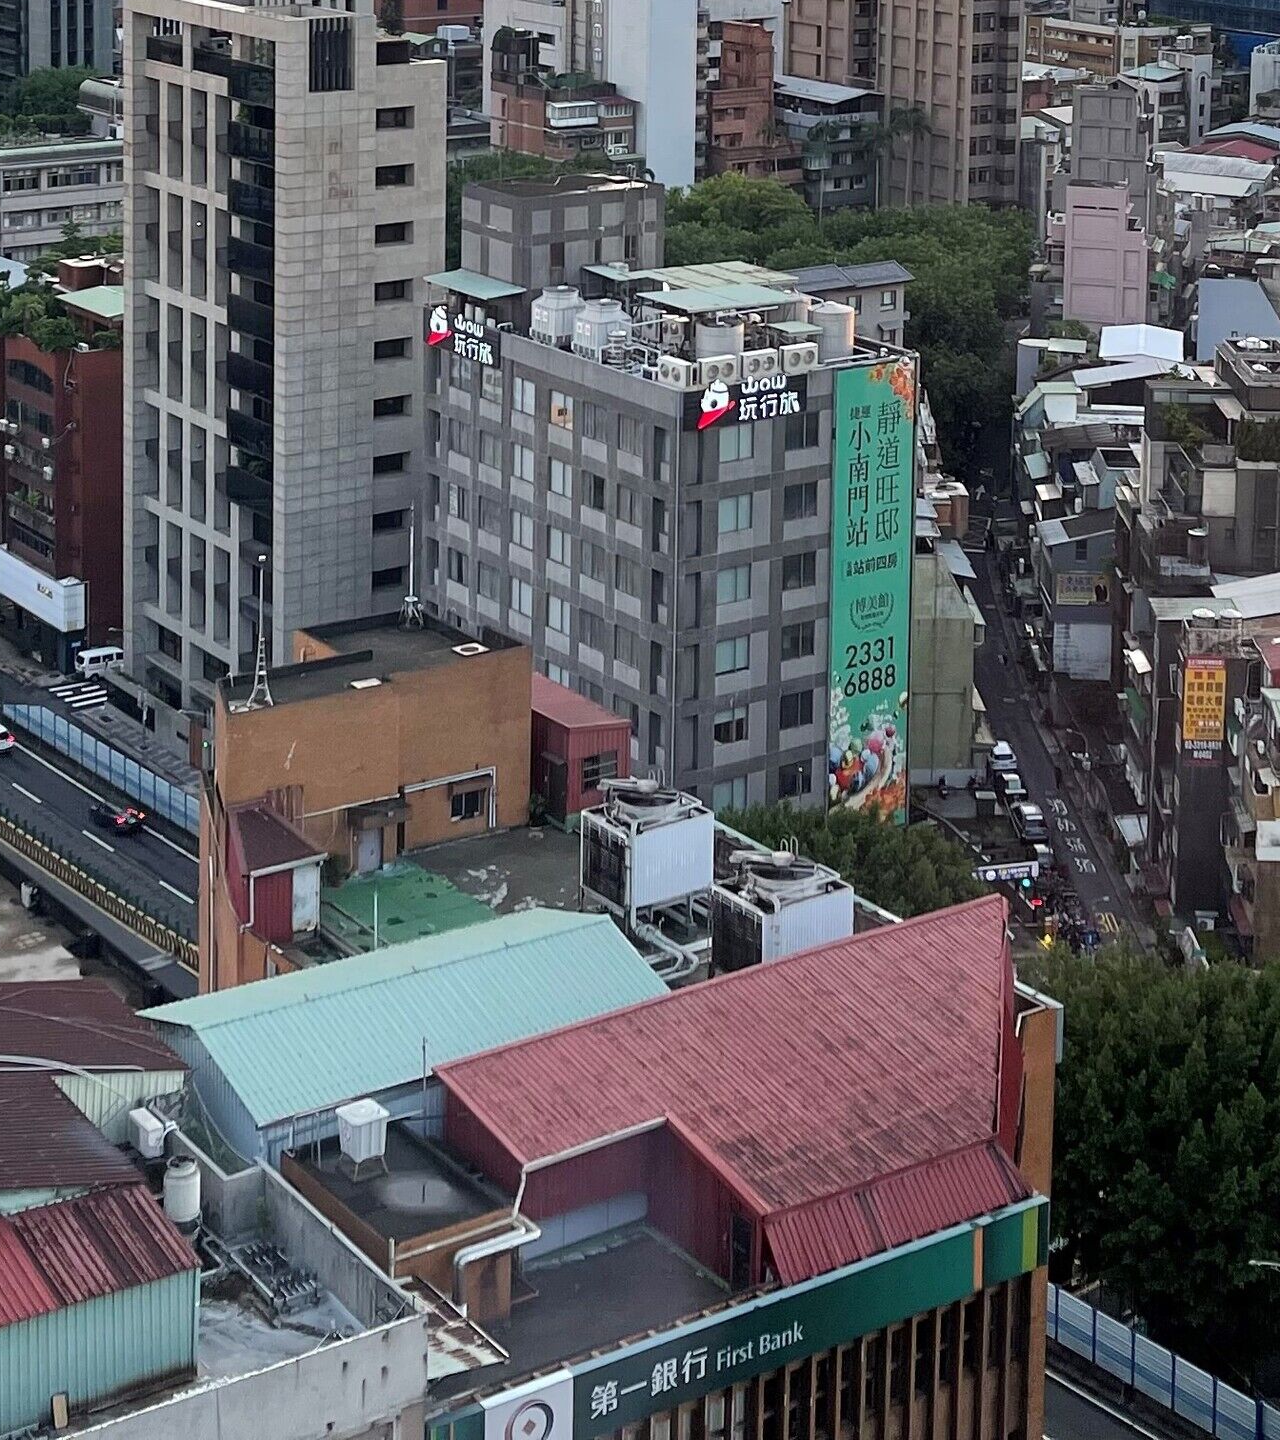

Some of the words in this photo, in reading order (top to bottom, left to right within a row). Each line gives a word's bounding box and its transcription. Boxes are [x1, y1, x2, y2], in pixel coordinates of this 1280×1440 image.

[454, 333, 493, 365] 玩行旅
[738, 391, 800, 421] 玩行旅
[846, 421, 871, 548] 小南門站
[875, 399, 902, 542] 靜道旺邸
[845, 636, 895, 670] 2331
[844, 663, 896, 698] 6888
[590, 1346, 709, 1420] 第一銀行
[716, 1340, 754, 1372] First
[758, 1320, 804, 1356] Bank
